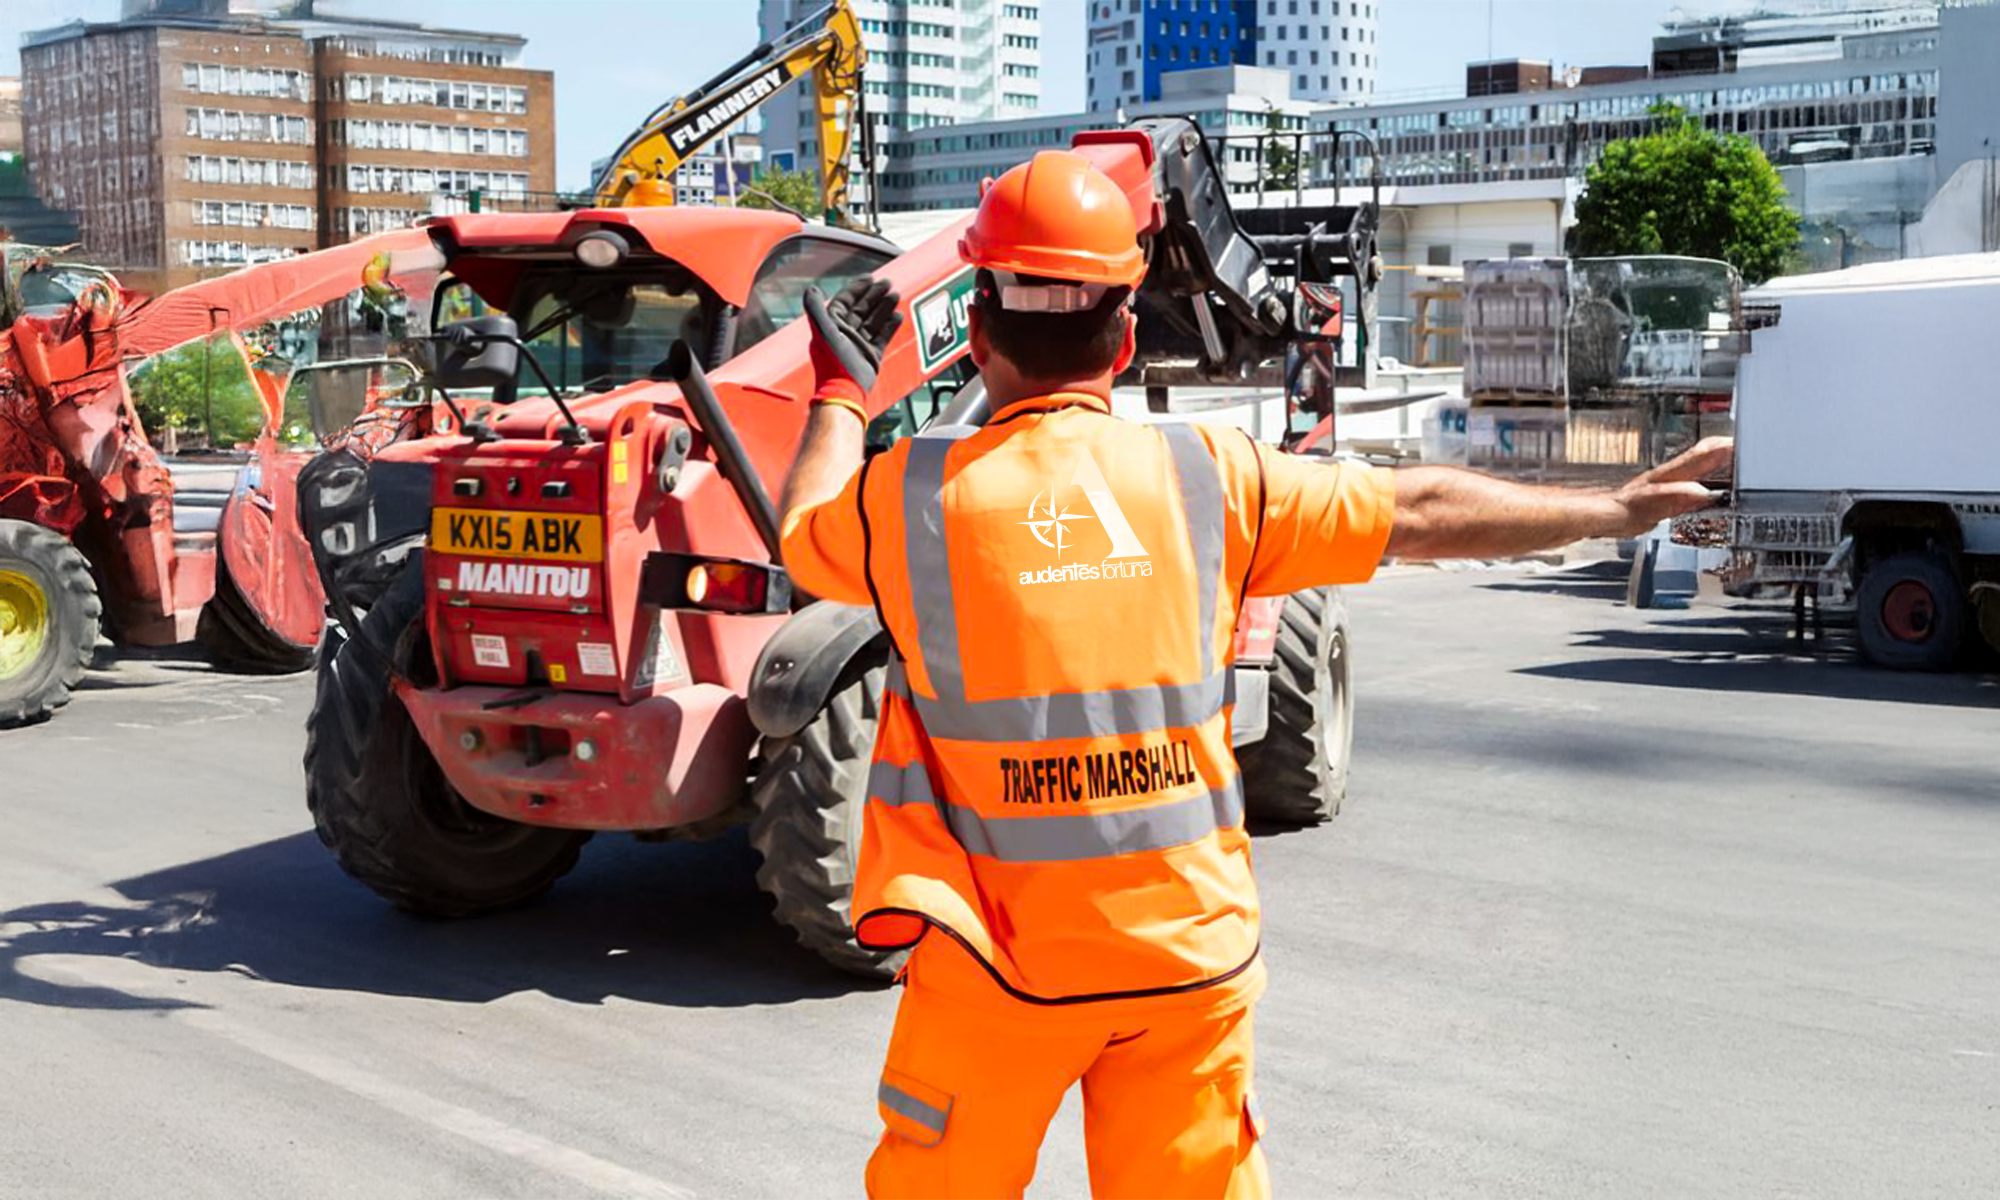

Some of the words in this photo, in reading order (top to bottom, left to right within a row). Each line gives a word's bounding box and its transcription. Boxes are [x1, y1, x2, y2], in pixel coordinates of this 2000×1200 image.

[671, 67, 781, 150] FLANNERY
[450, 513, 513, 551] KX15
[523, 518, 582, 554] ABK
[458, 562, 590, 599] MANITOU
[1019, 562, 1100, 585] audentes
[1100, 559, 1153, 580] fortuna
[1000, 757, 1082, 804] TRAFFIC
[1085, 739, 1195, 800] MARSHALL
